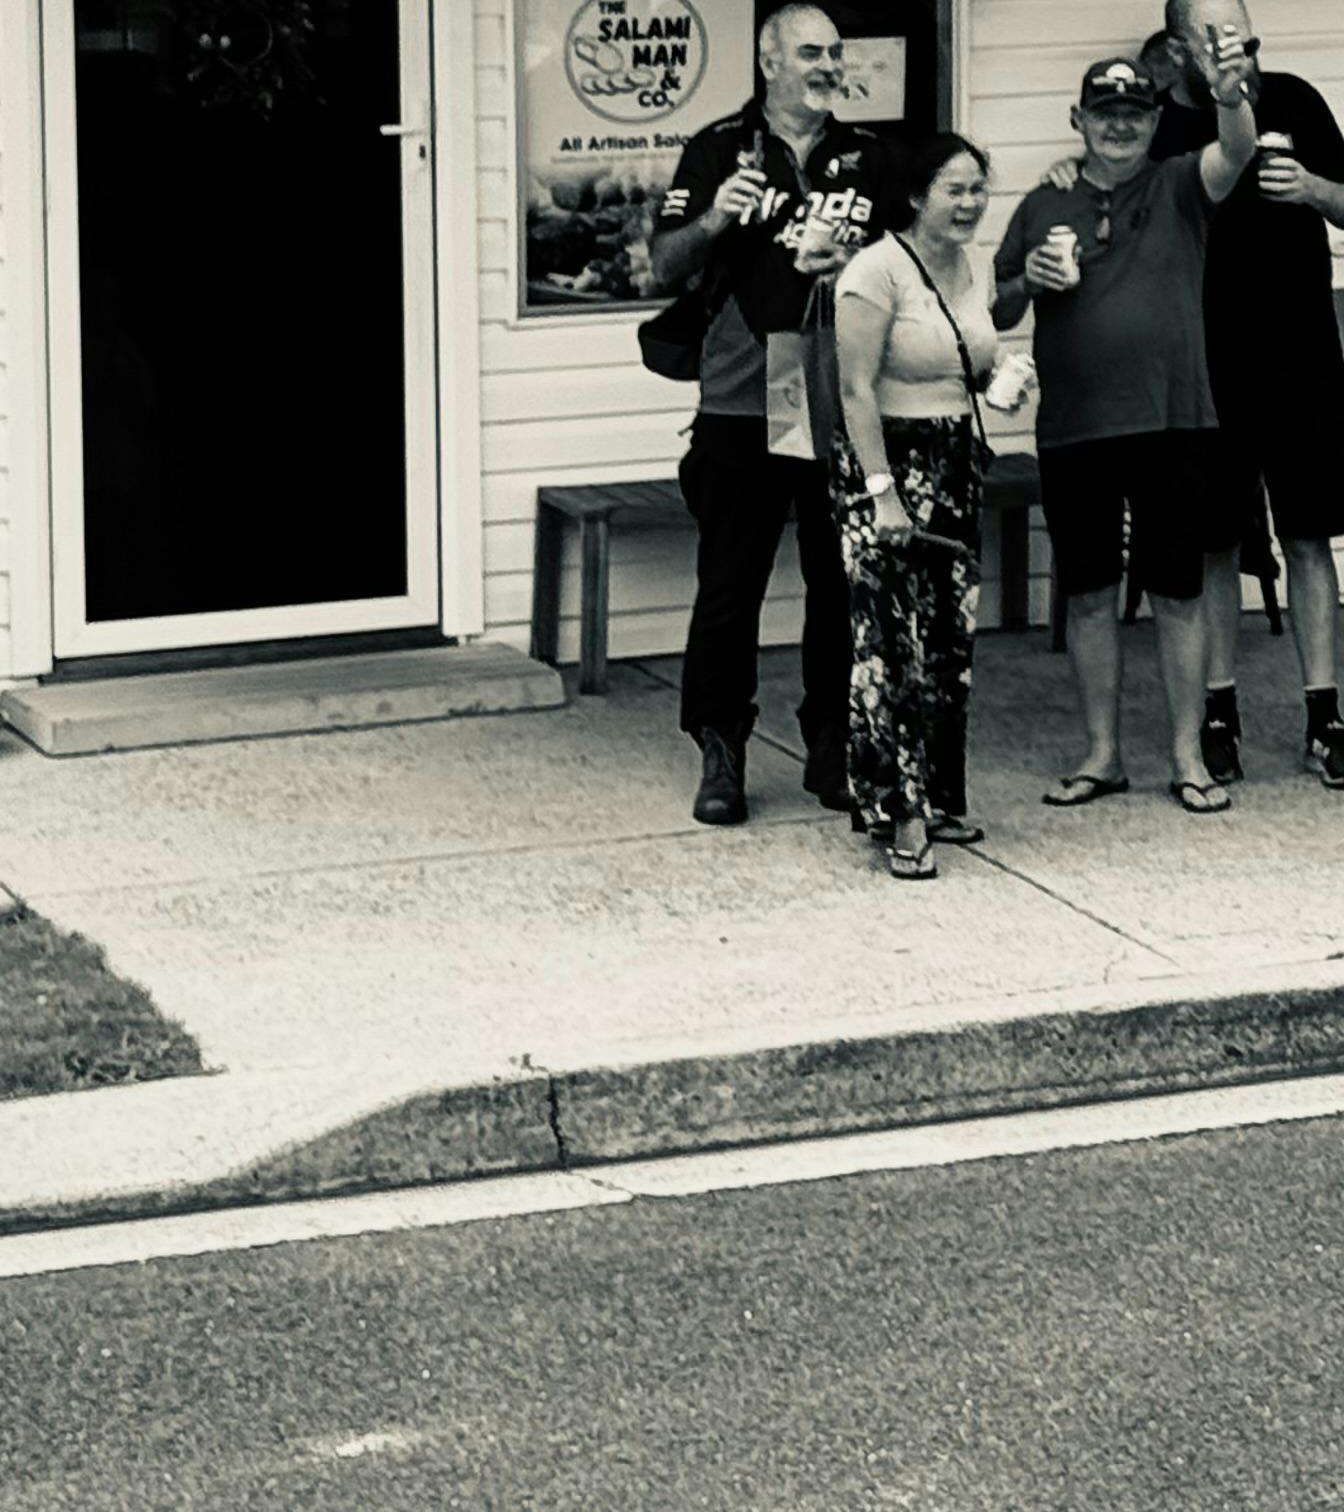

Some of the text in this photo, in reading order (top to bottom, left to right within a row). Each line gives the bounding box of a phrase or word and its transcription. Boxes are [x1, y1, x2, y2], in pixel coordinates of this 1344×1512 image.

[598, 0, 627, 15] THE
[598, 15, 692, 43] SALAMI
[632, 44, 688, 68] MAN
[660, 68, 682, 90] &
[559, 137, 582, 151] All
[588, 135, 649, 151] Artisan
